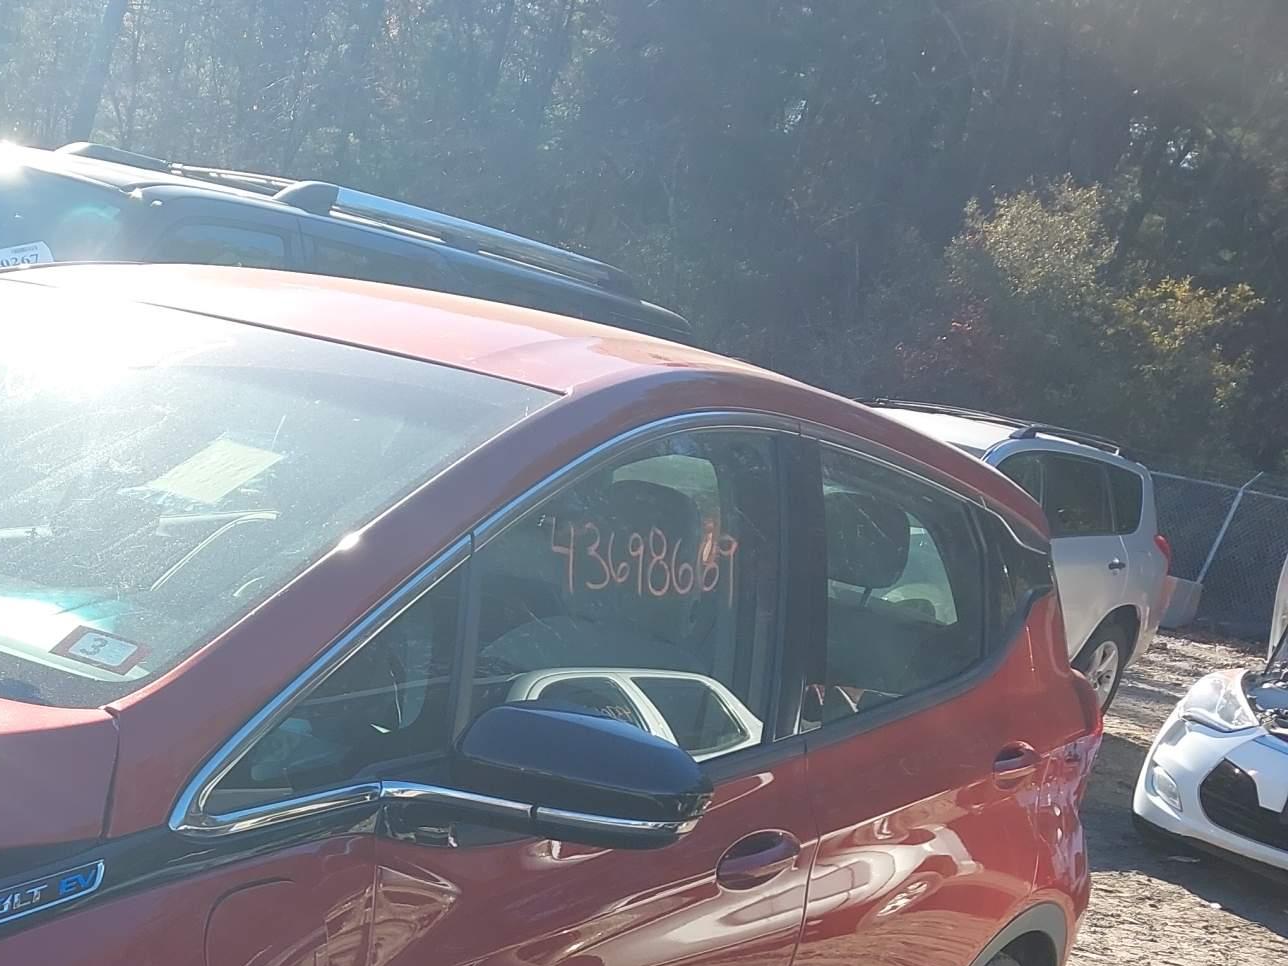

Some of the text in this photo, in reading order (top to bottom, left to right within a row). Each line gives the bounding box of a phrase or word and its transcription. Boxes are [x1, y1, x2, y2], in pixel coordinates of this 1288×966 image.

[551, 515, 739, 609] 43698669
[79, 638, 109, 656] 3
[58, 868, 97, 896] EV
